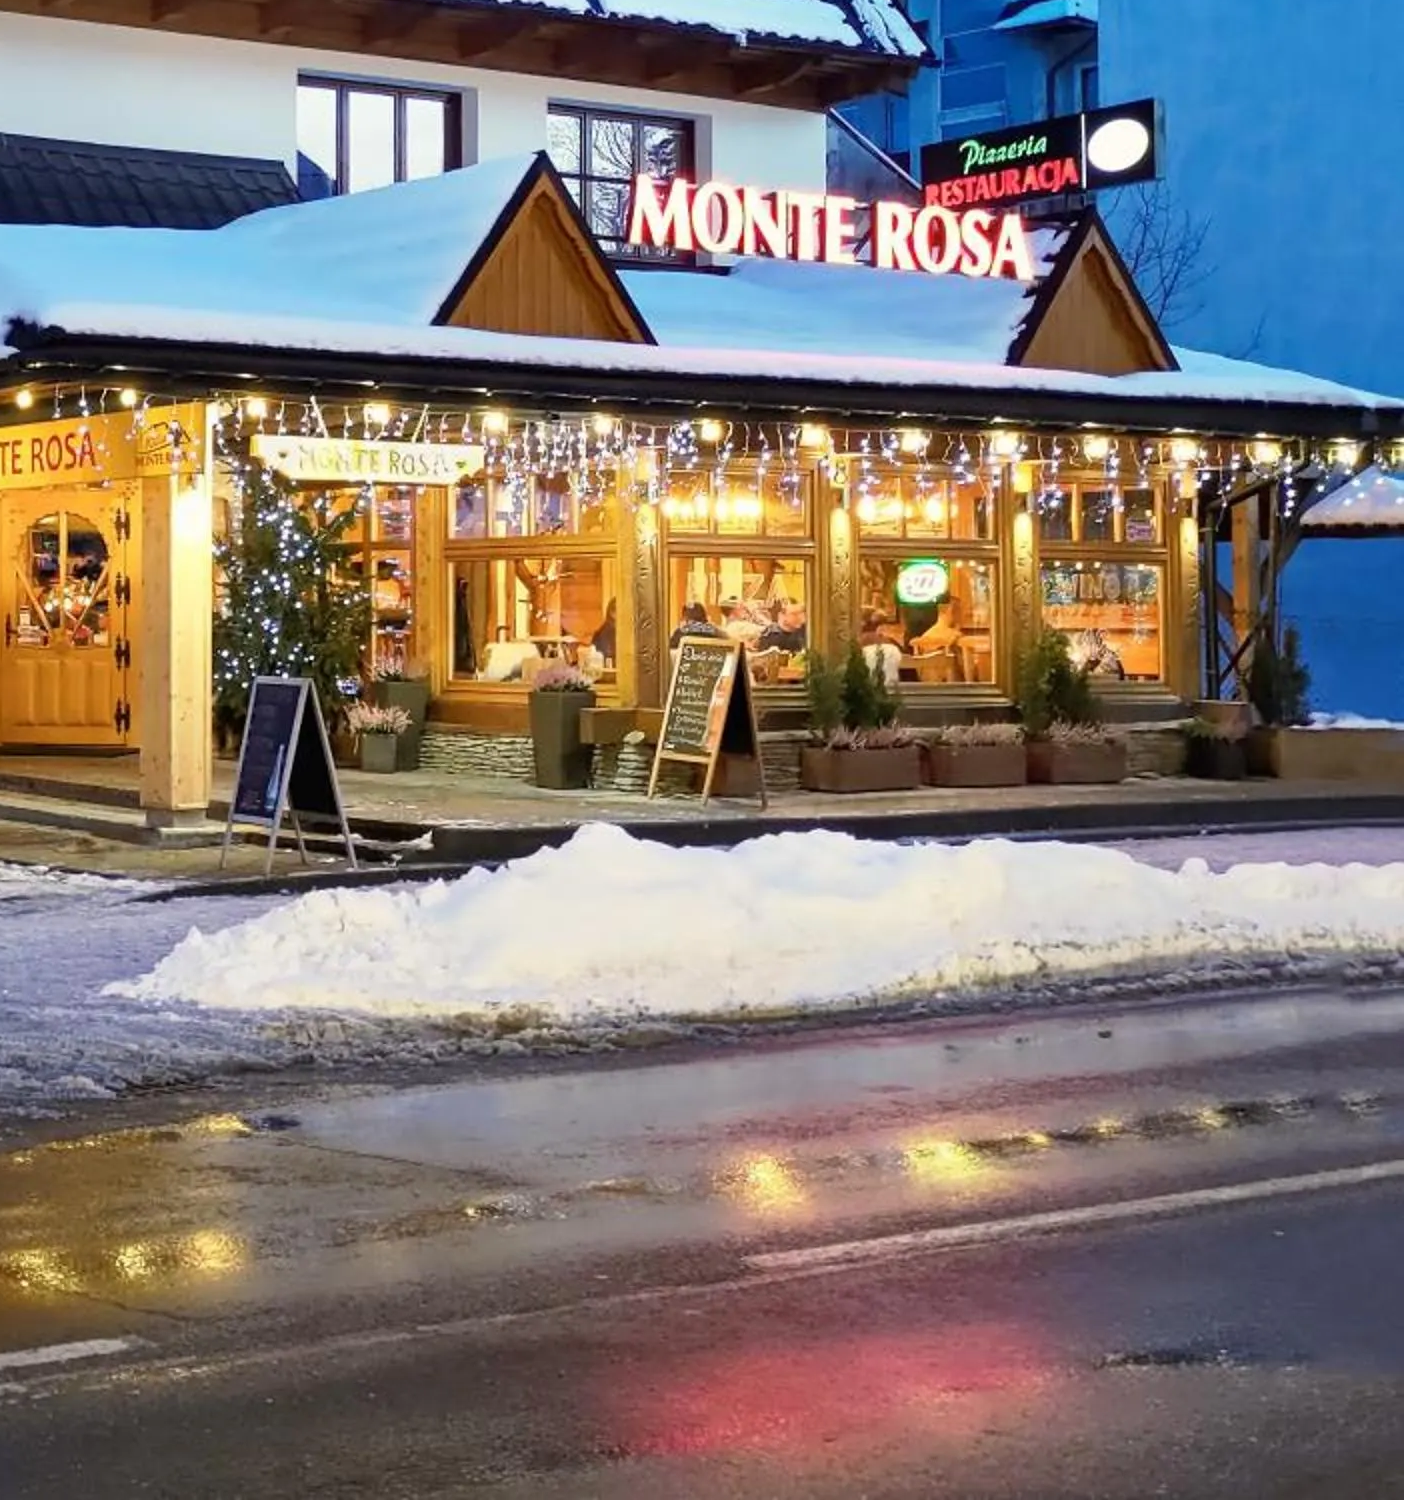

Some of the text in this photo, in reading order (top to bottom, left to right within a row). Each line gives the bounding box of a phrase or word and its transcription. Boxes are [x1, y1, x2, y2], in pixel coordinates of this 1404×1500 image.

[959, 135, 1047, 175] Pizzeria
[925, 157, 1079, 208] RESTAURACJA
[627, 173, 1036, 281] MONTE ROSA
[31, 431, 96, 474] ROSA
[298, 444, 451, 477] MONTE ROSA
